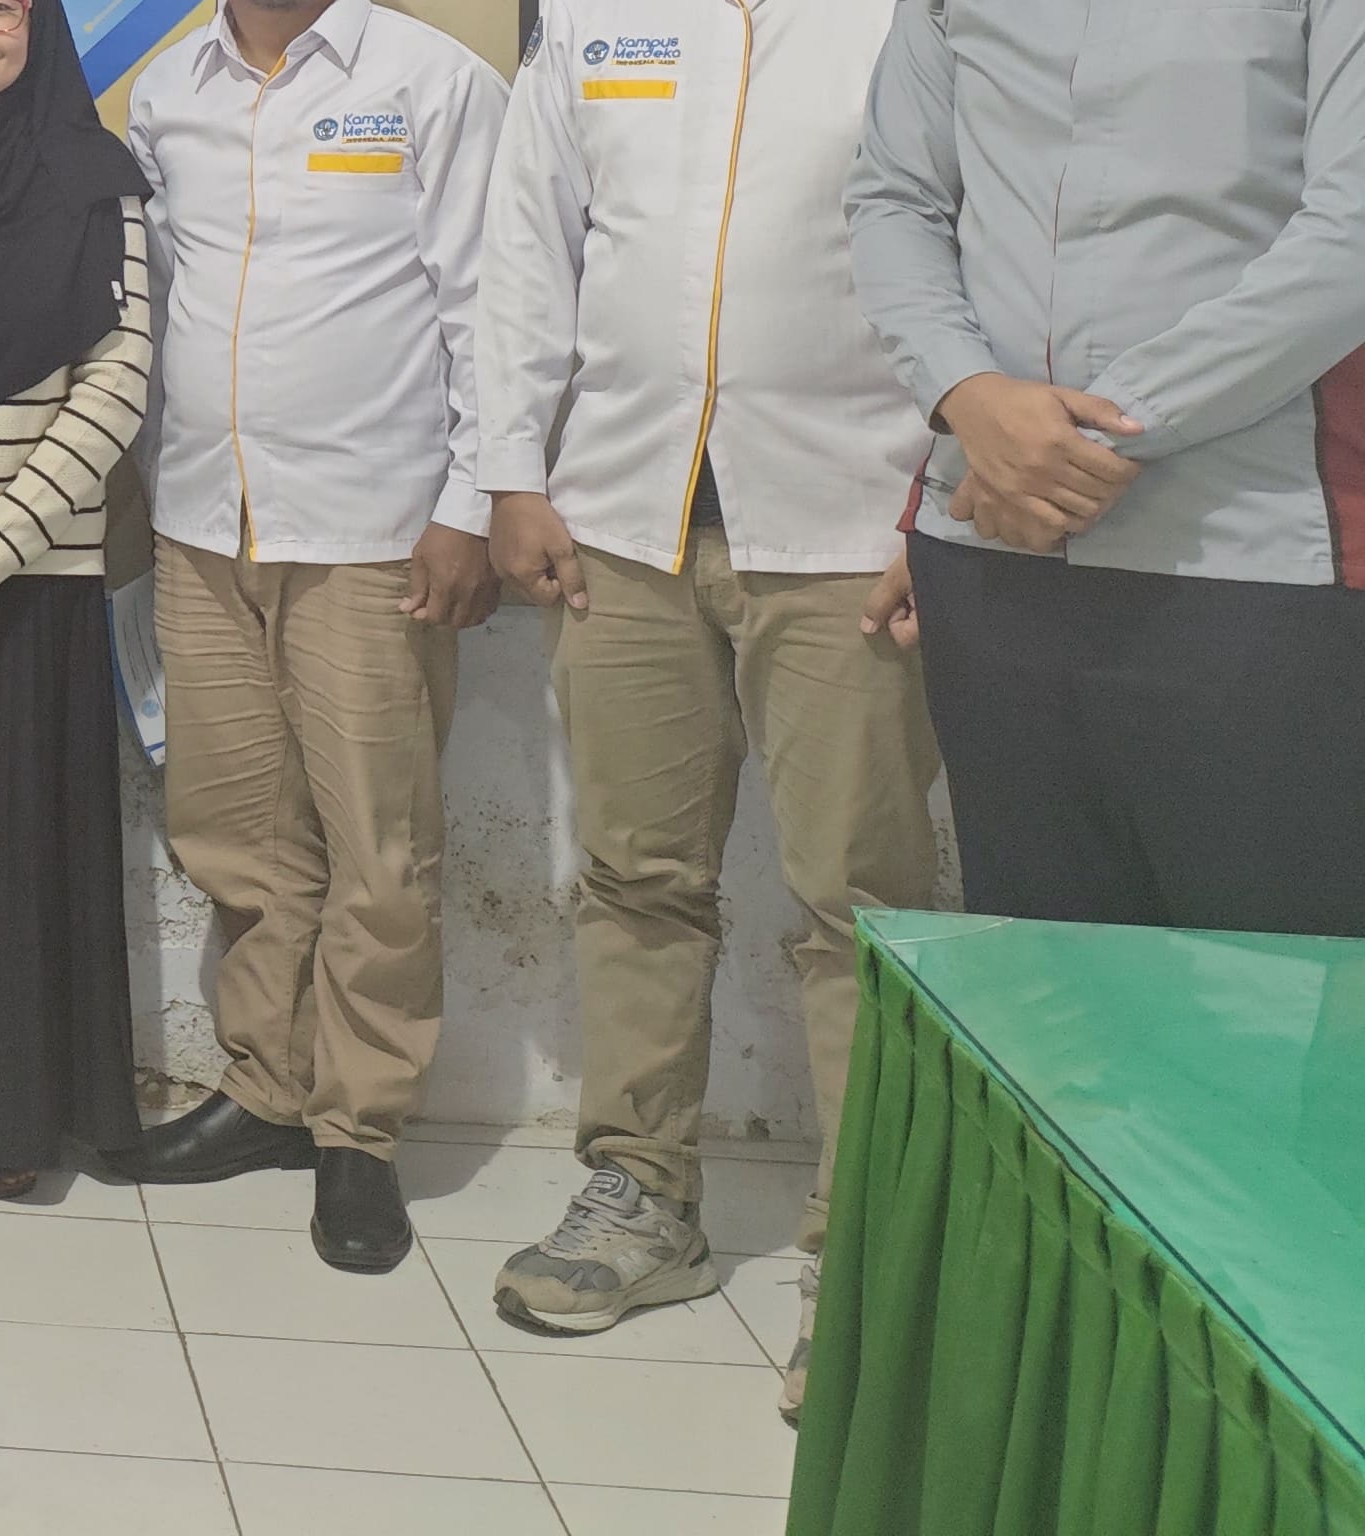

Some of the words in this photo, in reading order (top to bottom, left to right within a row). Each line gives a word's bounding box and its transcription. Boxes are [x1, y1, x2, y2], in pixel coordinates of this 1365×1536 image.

[616, 36, 679, 48] Kampus
[612, 47, 681, 59] Merdeka
[343, 113, 404, 126] Kampus
[342, 124, 408, 137] Merdeka
